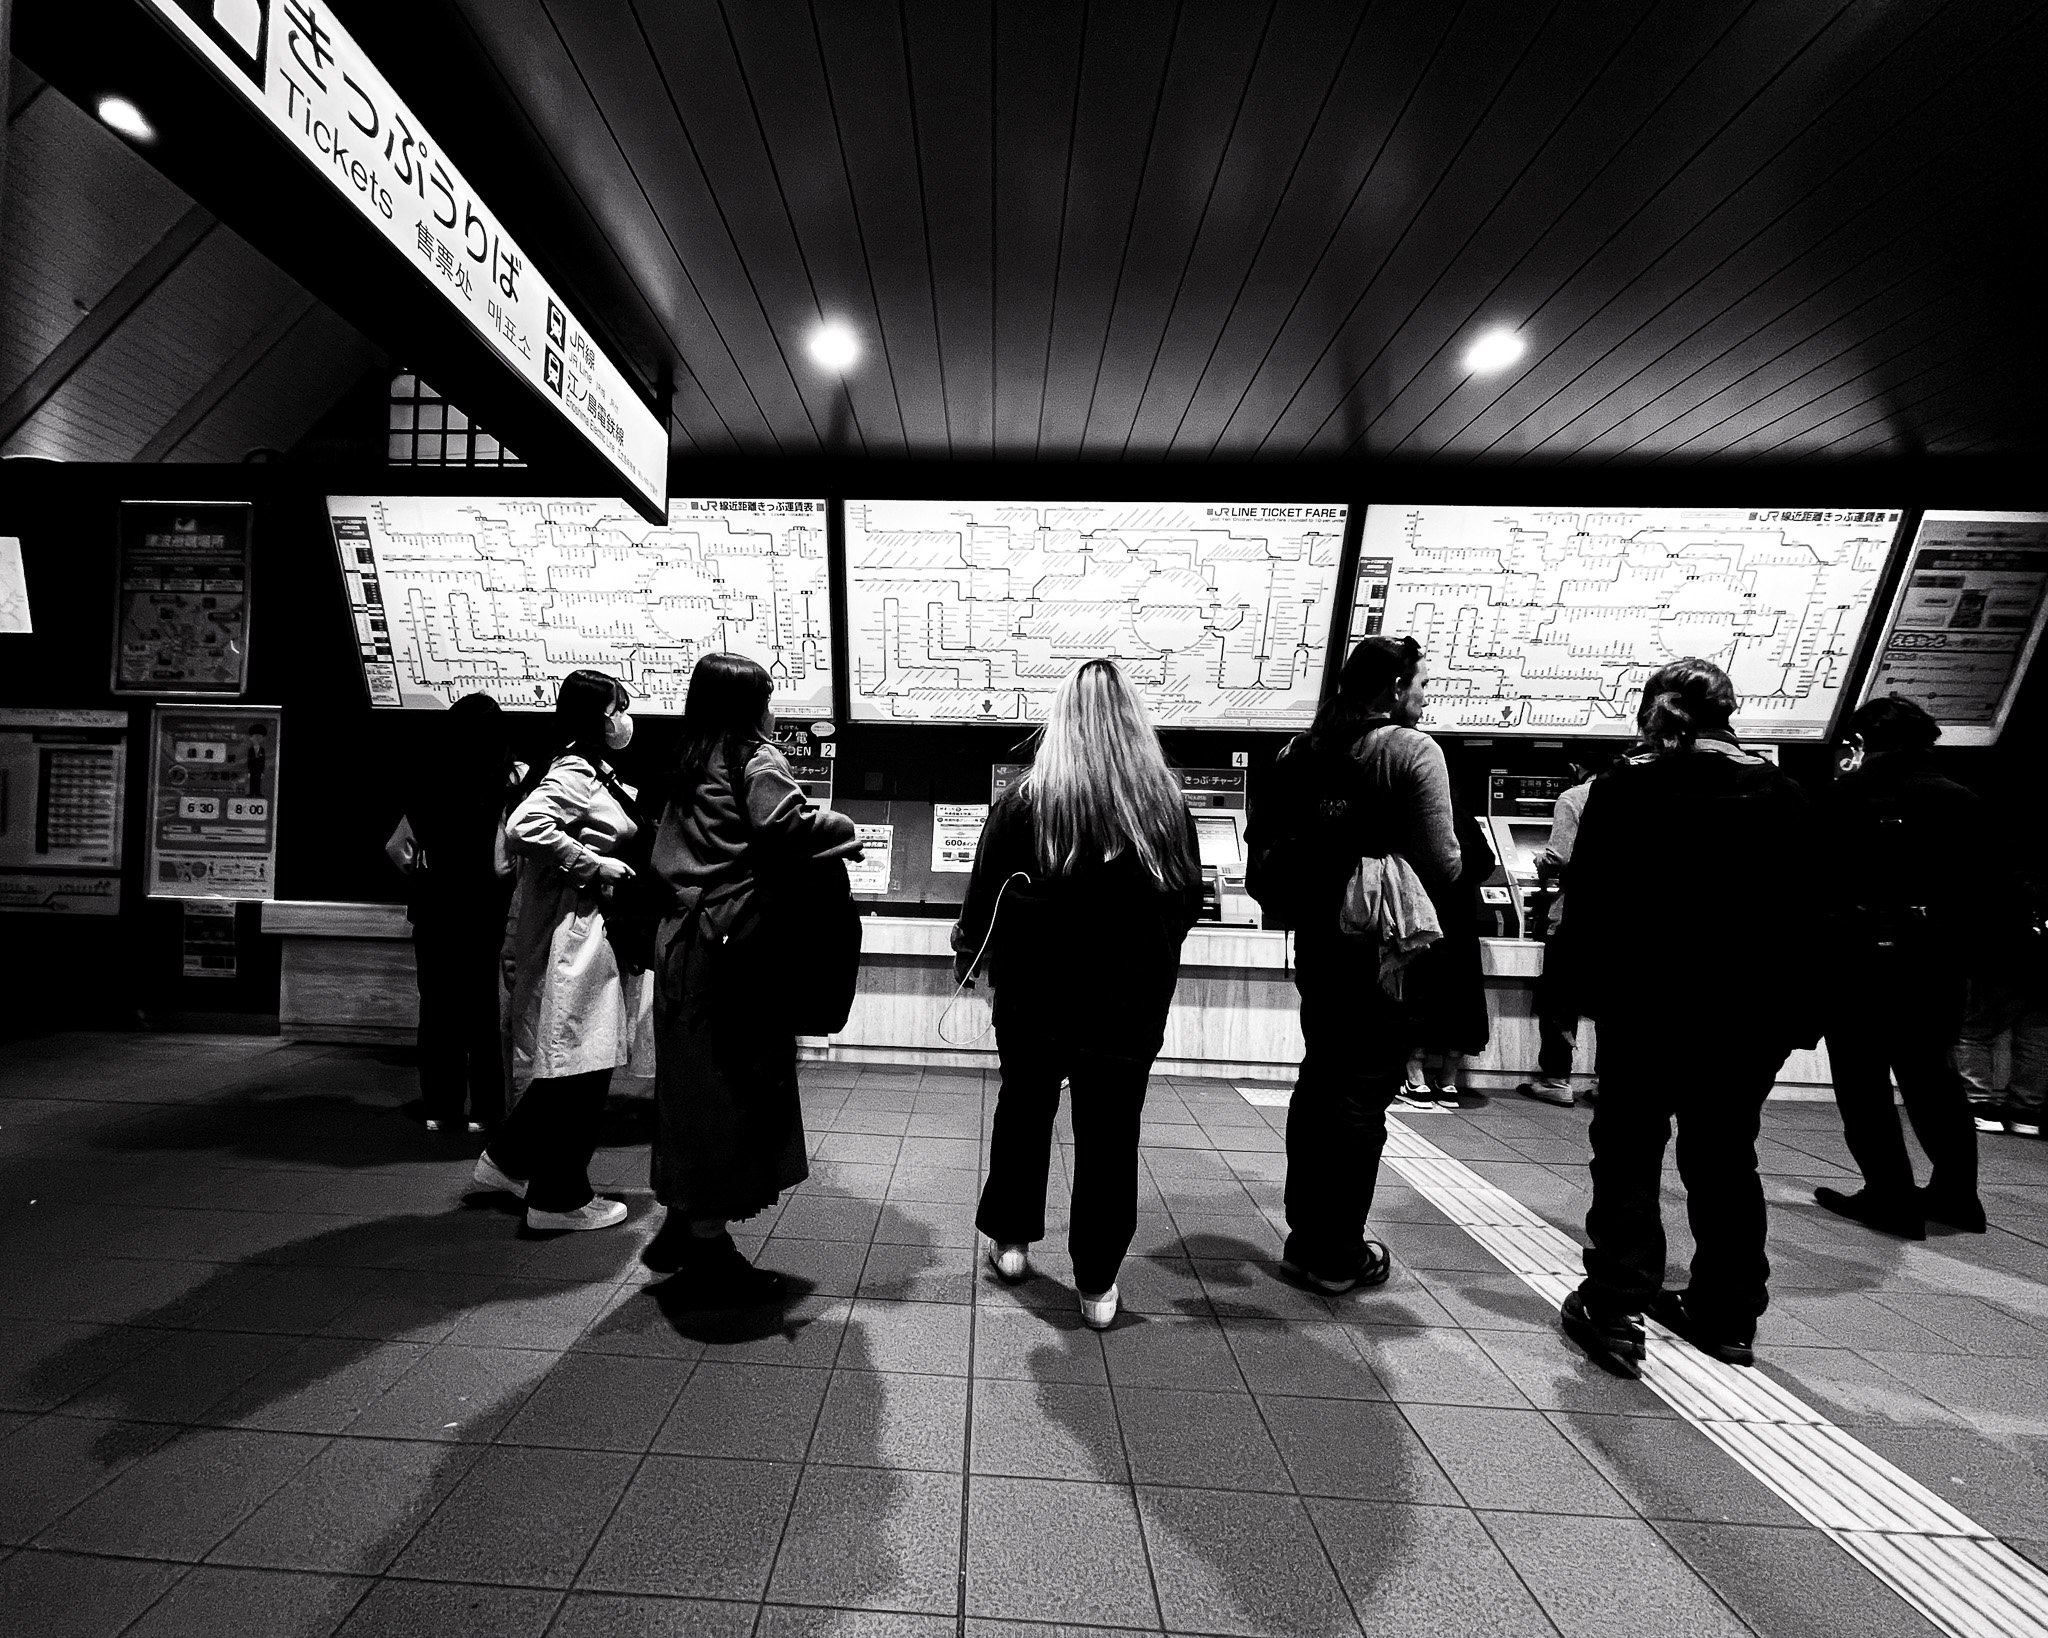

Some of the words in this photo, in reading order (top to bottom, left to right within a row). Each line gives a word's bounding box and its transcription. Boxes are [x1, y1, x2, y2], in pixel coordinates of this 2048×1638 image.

[279, 67, 393, 219] Tickets
[415, 219, 472, 302] 售票处
[487, 299, 531, 361] 매표소
[569, 331, 595, 371] JR線
[567, 369, 625, 448] 江ノ島電鉄線
[1214, 507, 1230, 516] JR
[1231, 507, 1258, 517] LINE
[1261, 507, 1303, 517] TICKET
[1305, 508, 1337, 518] FARE
[825, 744, 832, 757] 2
[1236, 753, 1243, 767] 4
